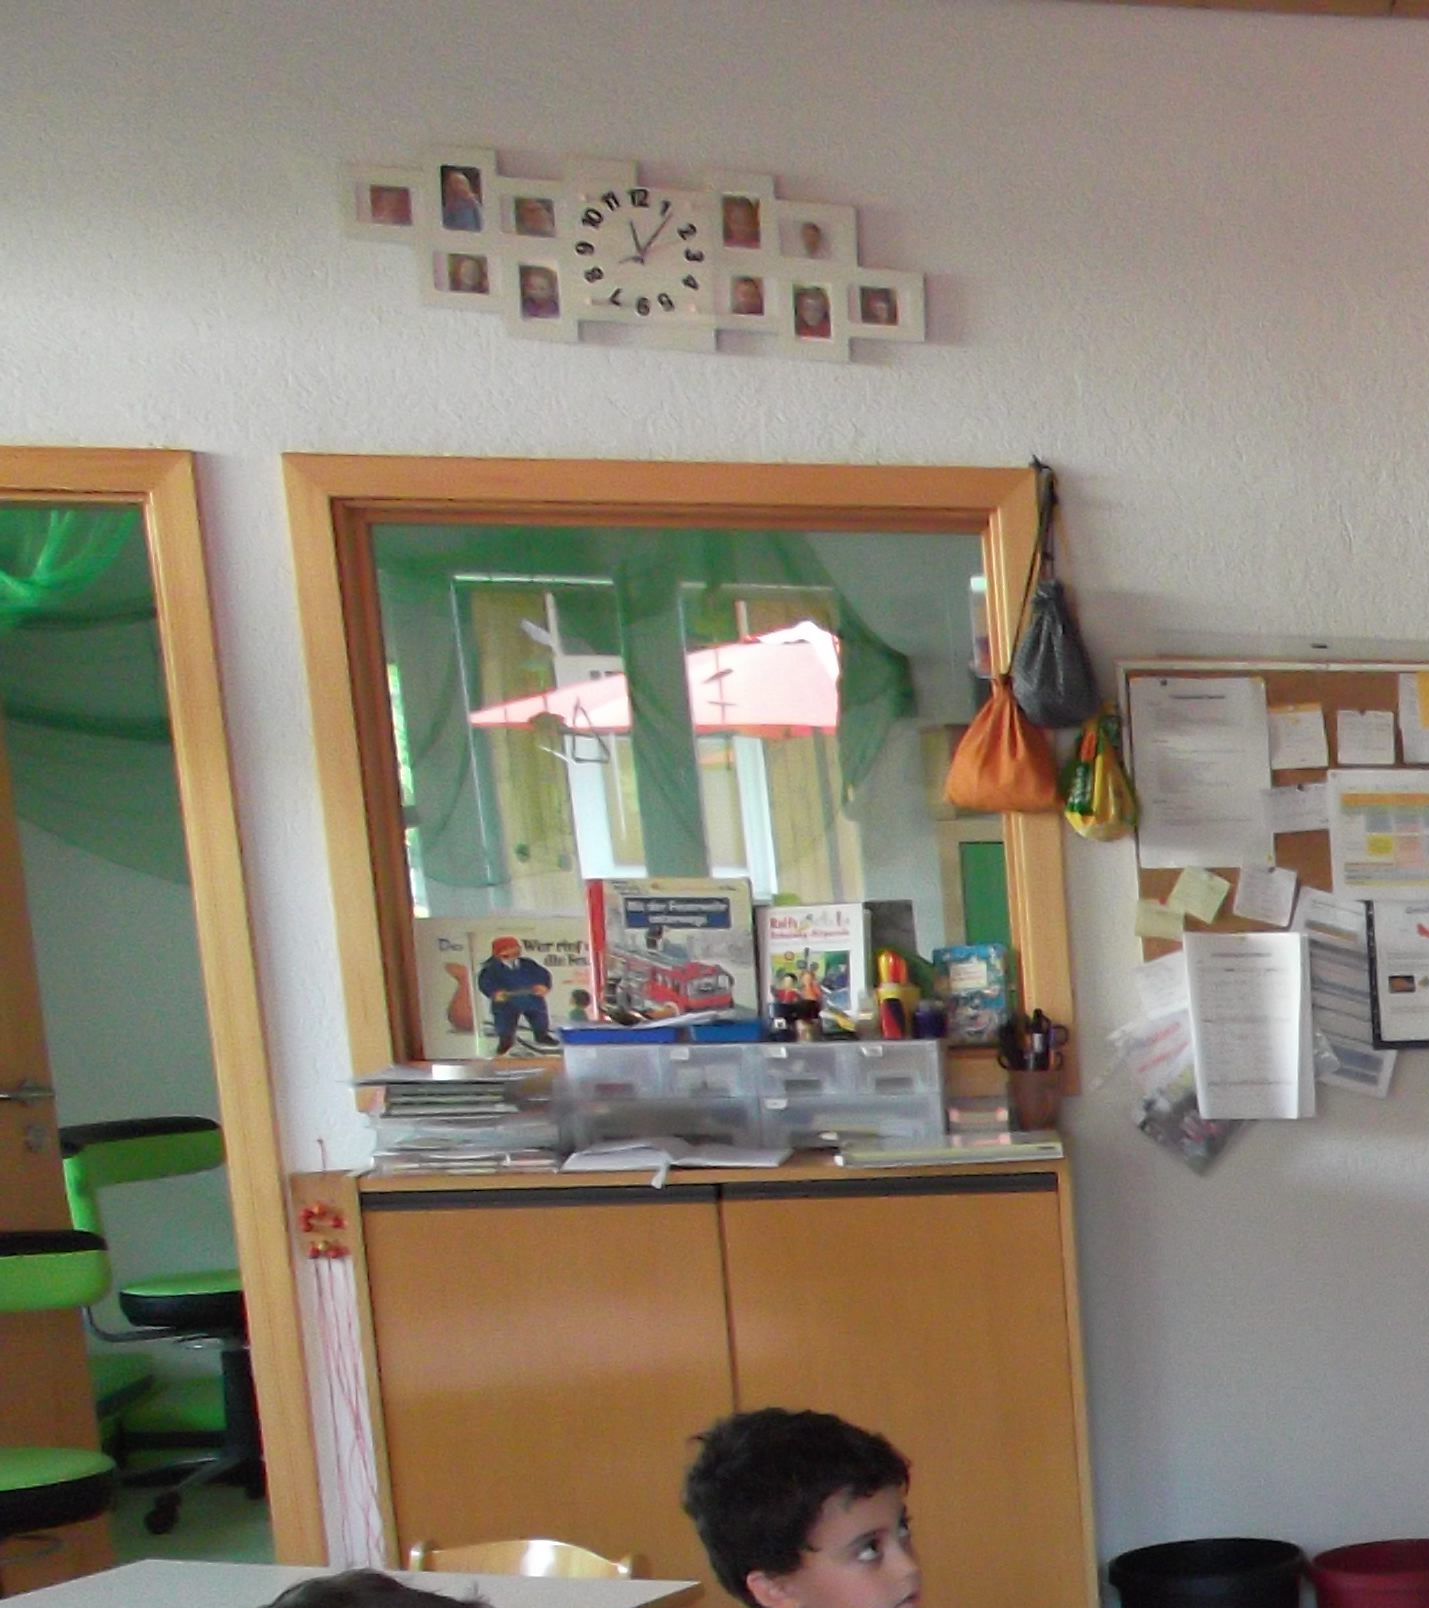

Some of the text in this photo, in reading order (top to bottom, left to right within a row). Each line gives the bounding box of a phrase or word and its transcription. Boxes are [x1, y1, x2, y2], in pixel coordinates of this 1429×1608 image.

[602, 191, 620, 211] 11
[629, 188, 649, 208] 12
[661, 199, 671, 217] 1
[581, 207, 604, 229] 10
[677, 223, 697, 240] 2
[575, 241, 595, 256] 9
[684, 246, 704, 262] 3
[584, 266, 604, 283] 8
[682, 274, 699, 291] 4
[609, 287, 623, 306] 7
[657, 292, 675, 312] 5
[636, 297, 650, 316] 6
